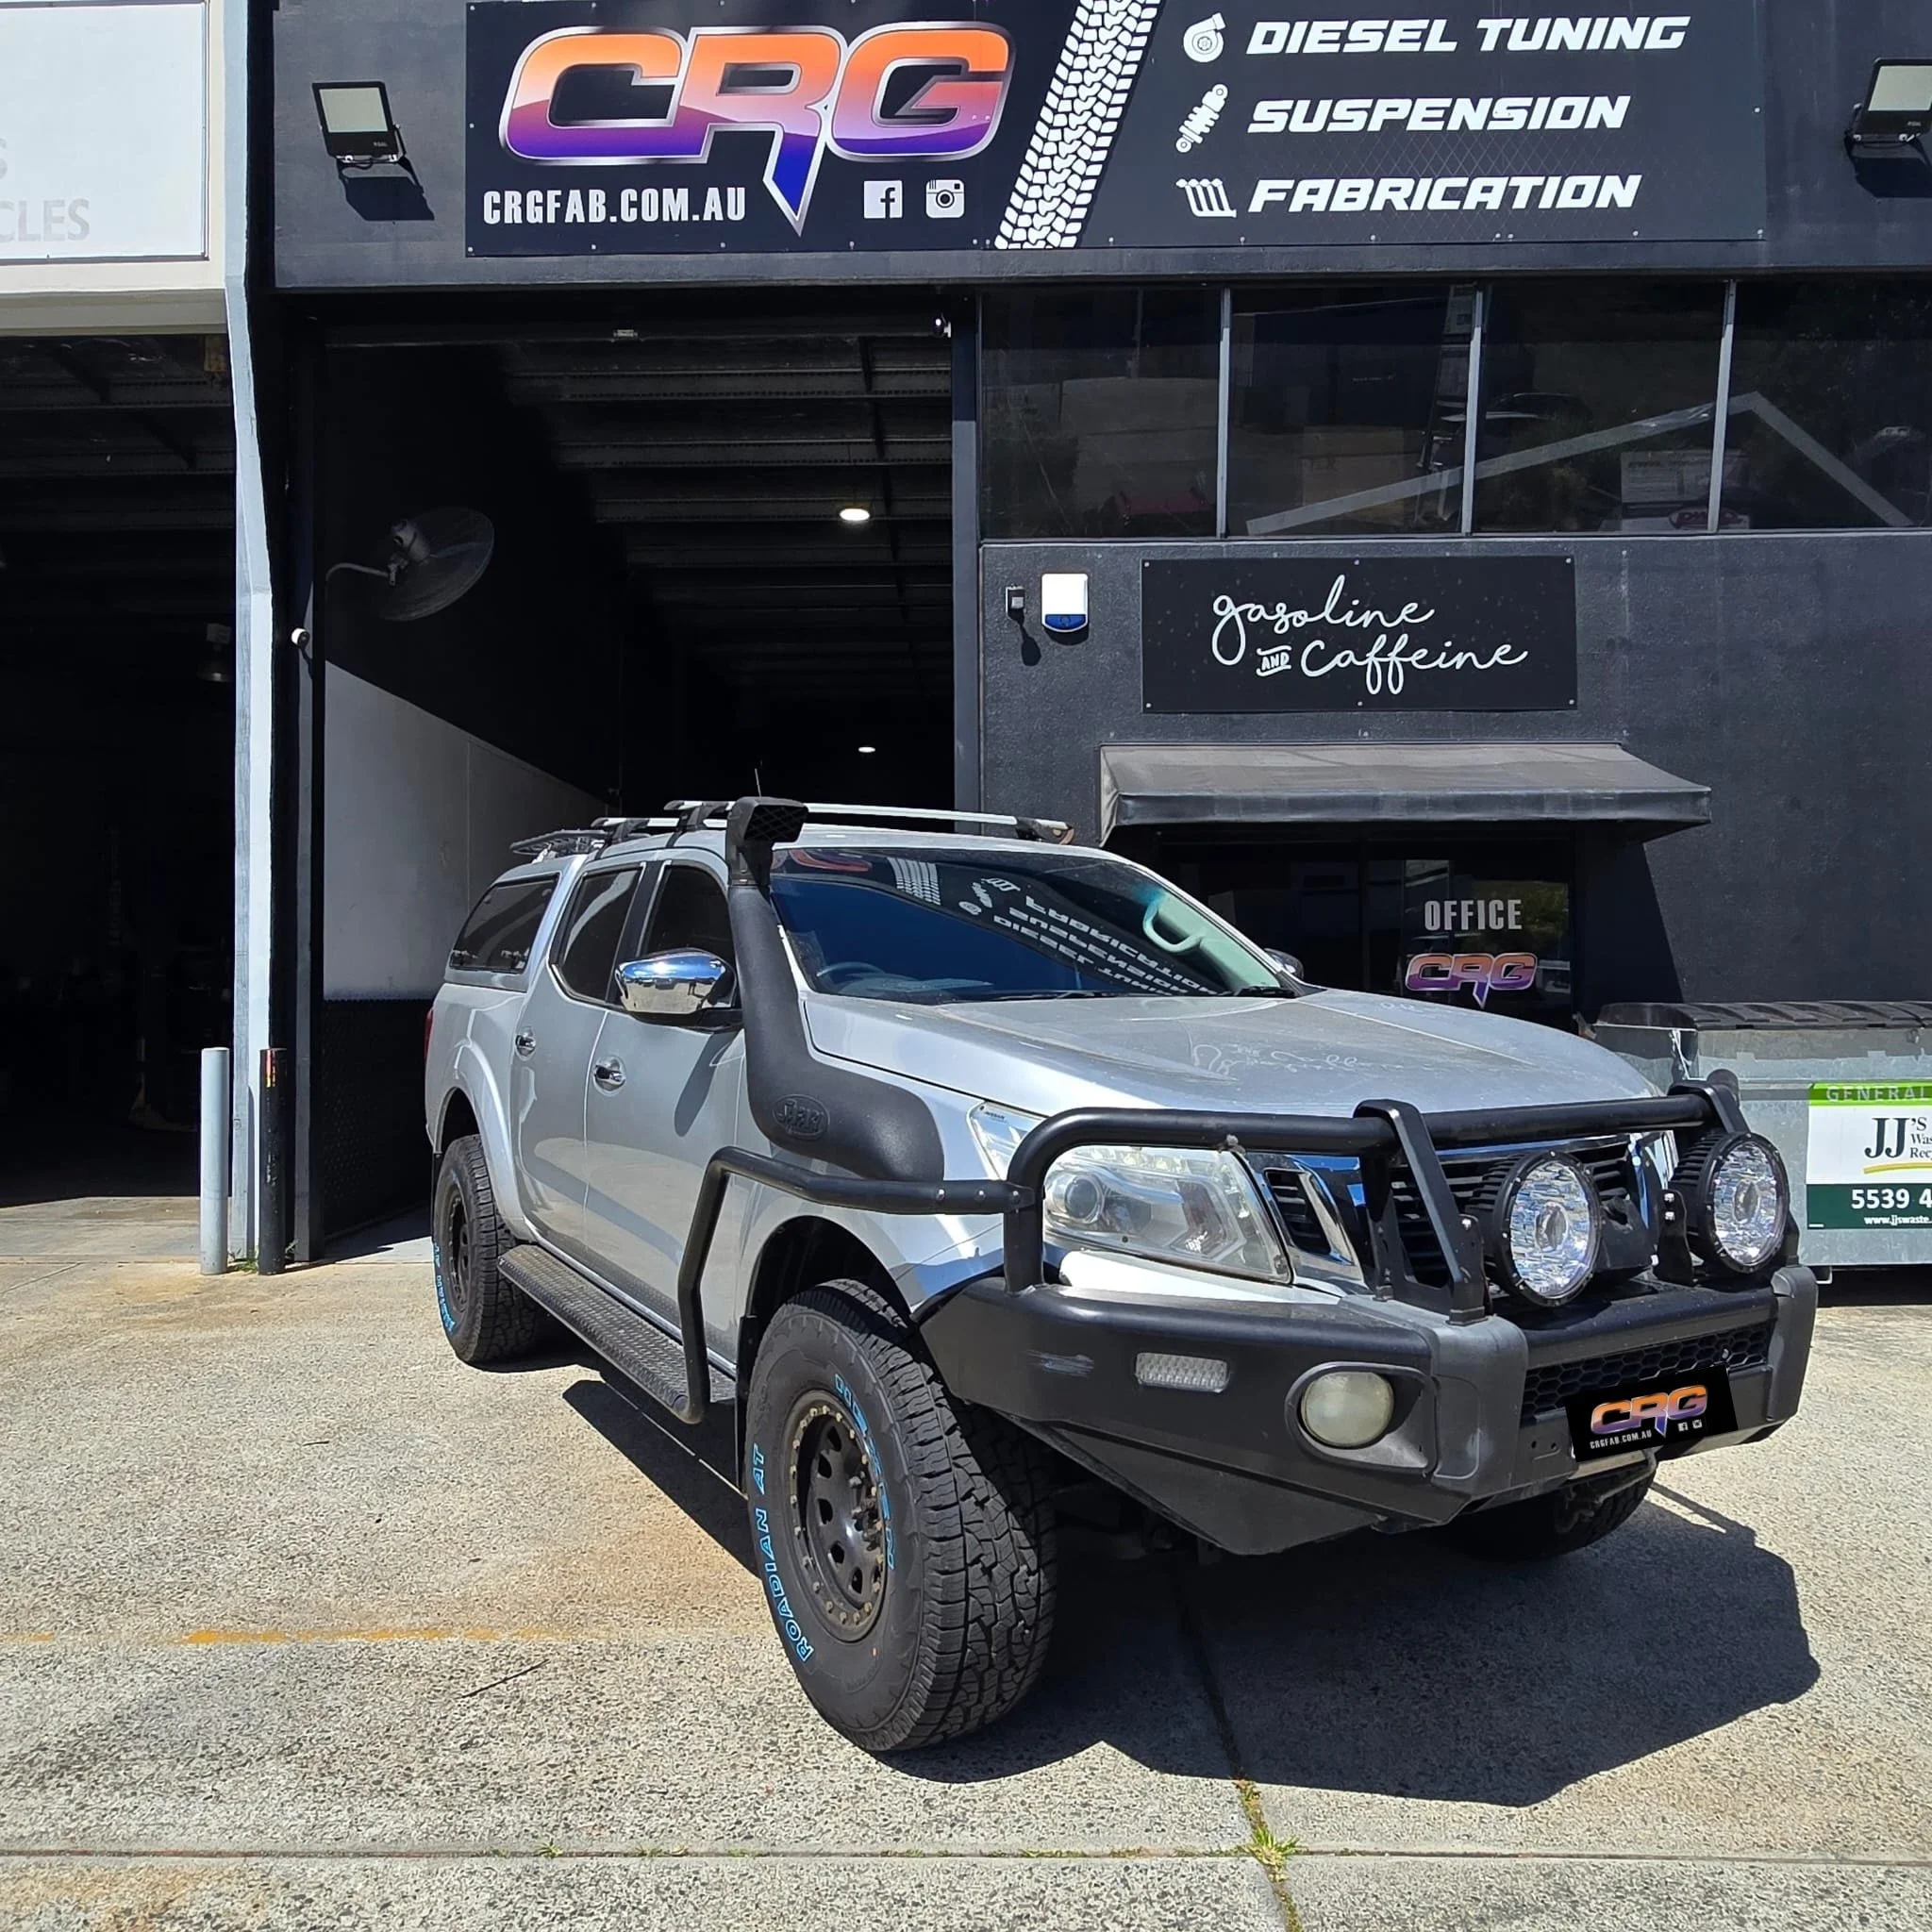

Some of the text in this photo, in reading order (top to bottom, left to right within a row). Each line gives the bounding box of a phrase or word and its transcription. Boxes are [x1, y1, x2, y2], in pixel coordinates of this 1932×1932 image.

[1245, 15, 1691, 56] DIESEL TUNING
[498, 21, 1016, 236] CRG
[1247, 95, 1631, 133] SUSPENSION
[482, 186, 747, 225] CRGFAB.COM.AU
[1248, 175, 1641, 213] FABRICATION
[1211, 574, 1436, 666] gasoline
[1259, 633, 1529, 695] AND Caffeine
[1424, 898, 1523, 931] OFFICE
[1405, 952, 1538, 1008] CRG
[1825, 1085, 1930, 1102] GENERAL
[1850, 1188, 1910, 1209] 5539
[753, 1442, 815, 1662] ROADIAN AT
